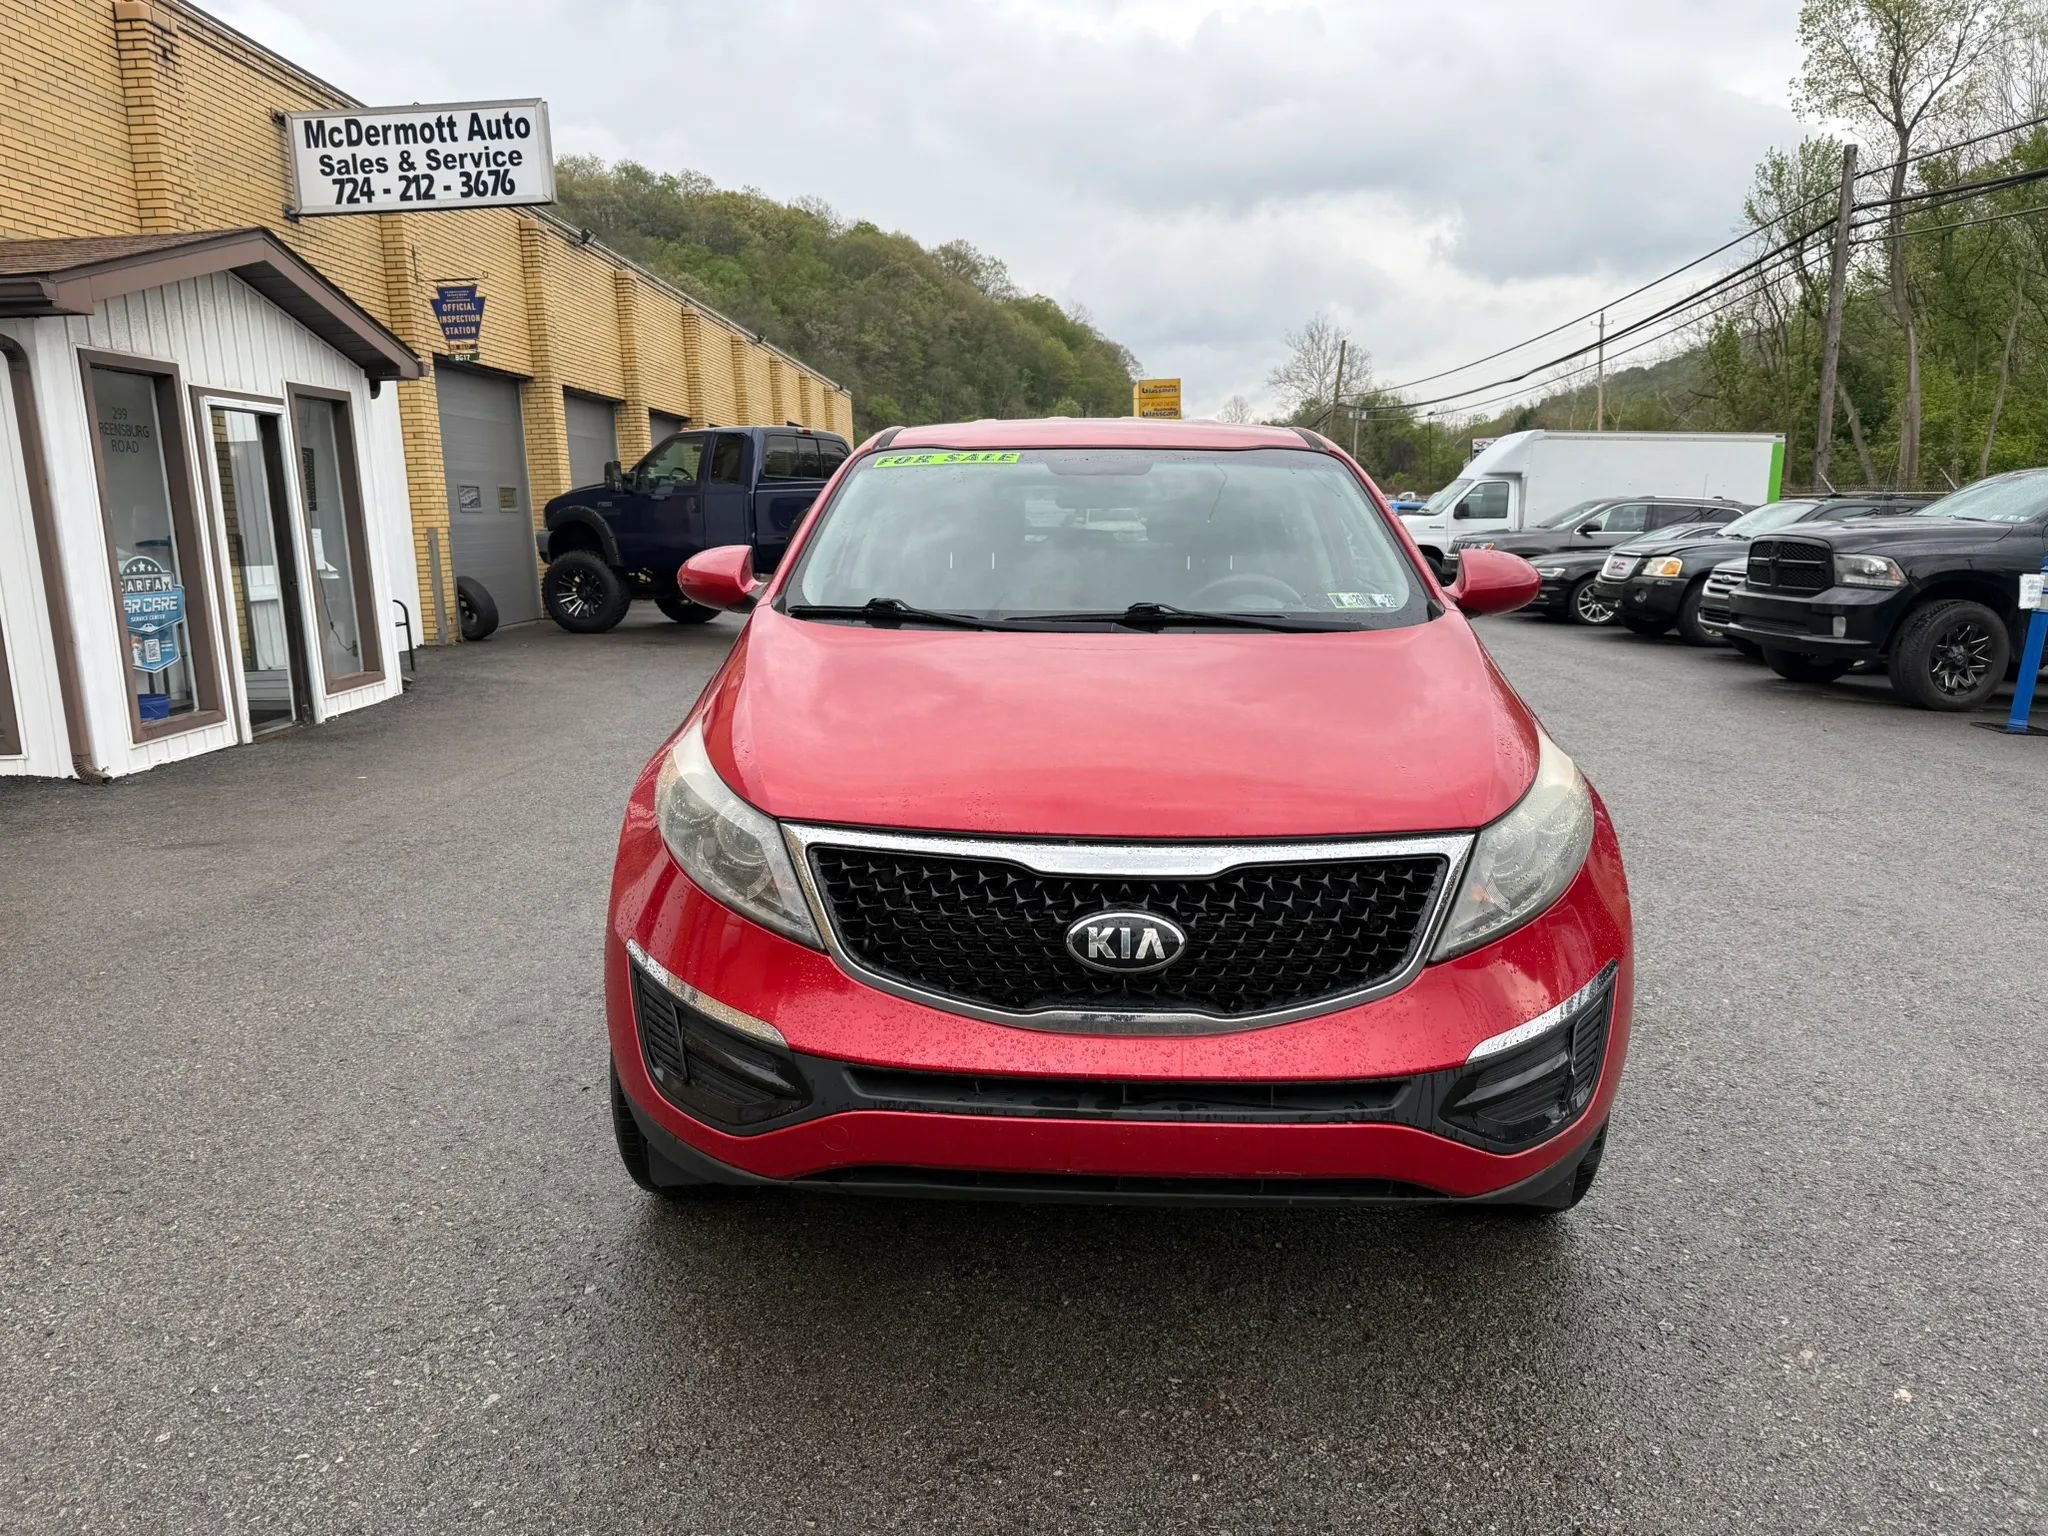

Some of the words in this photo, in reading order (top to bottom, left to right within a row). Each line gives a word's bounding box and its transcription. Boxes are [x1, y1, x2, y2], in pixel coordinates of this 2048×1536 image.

[303, 114, 459, 149] McDermott
[467, 111, 531, 142] Auto
[319, 153, 389, 177] Sales
[398, 150, 417, 172] &
[425, 146, 523, 172] Service
[332, 177, 375, 205] 724
[398, 174, 436, 201] 212
[459, 168, 516, 198] 3676
[442, 303, 476, 312] OFFICIAL
[439, 314, 480, 324] INSPECTION
[445, 326, 476, 335] STATION
[112, 407, 128, 420] 299
[99, 422, 150, 438] REENSBURG
[112, 439, 140, 453] ROAD
[876, 455, 934, 466] FOR
[944, 453, 1017, 462] SALE
[123, 599, 141, 613] AR
[143, 596, 178, 613] CARE
[1087, 926, 1166, 959] KIA
